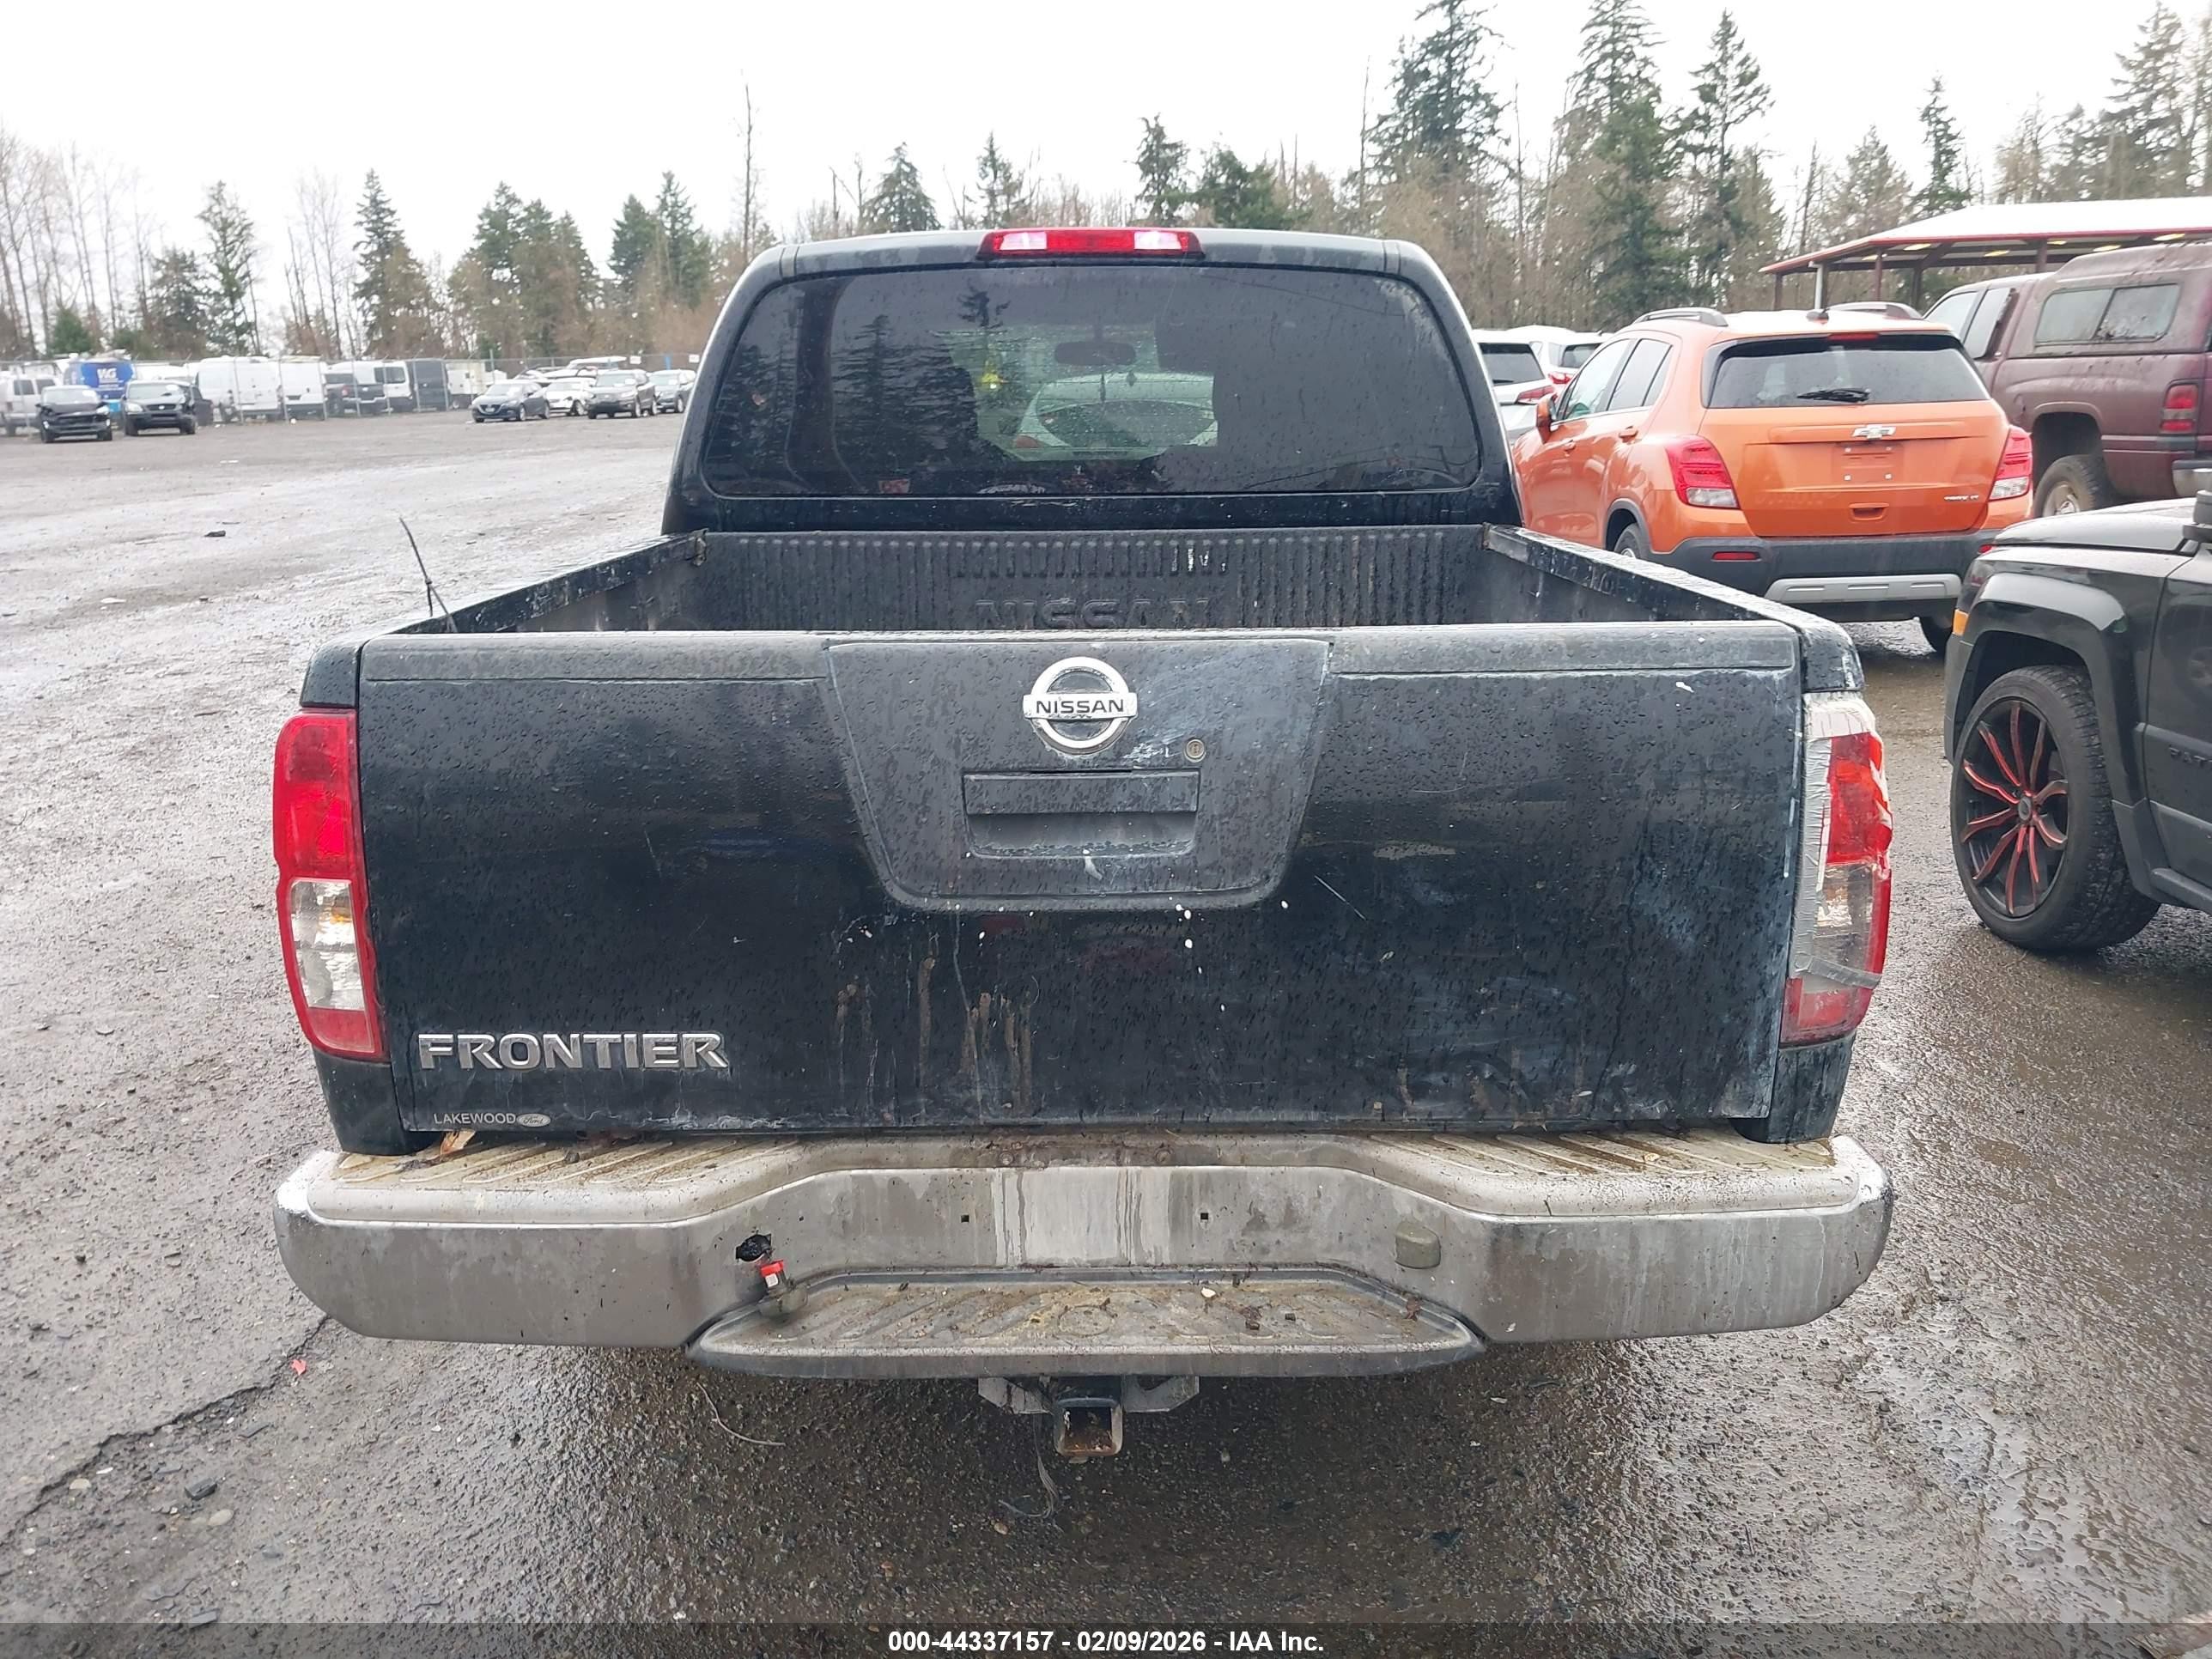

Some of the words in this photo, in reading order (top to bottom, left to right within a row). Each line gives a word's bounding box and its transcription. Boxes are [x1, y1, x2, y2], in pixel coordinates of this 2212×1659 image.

[1036, 699, 1124, 714] NISSAN
[418, 1033, 729, 1069] FRONTIER
[433, 1113, 516, 1124] LAKEWOOD
